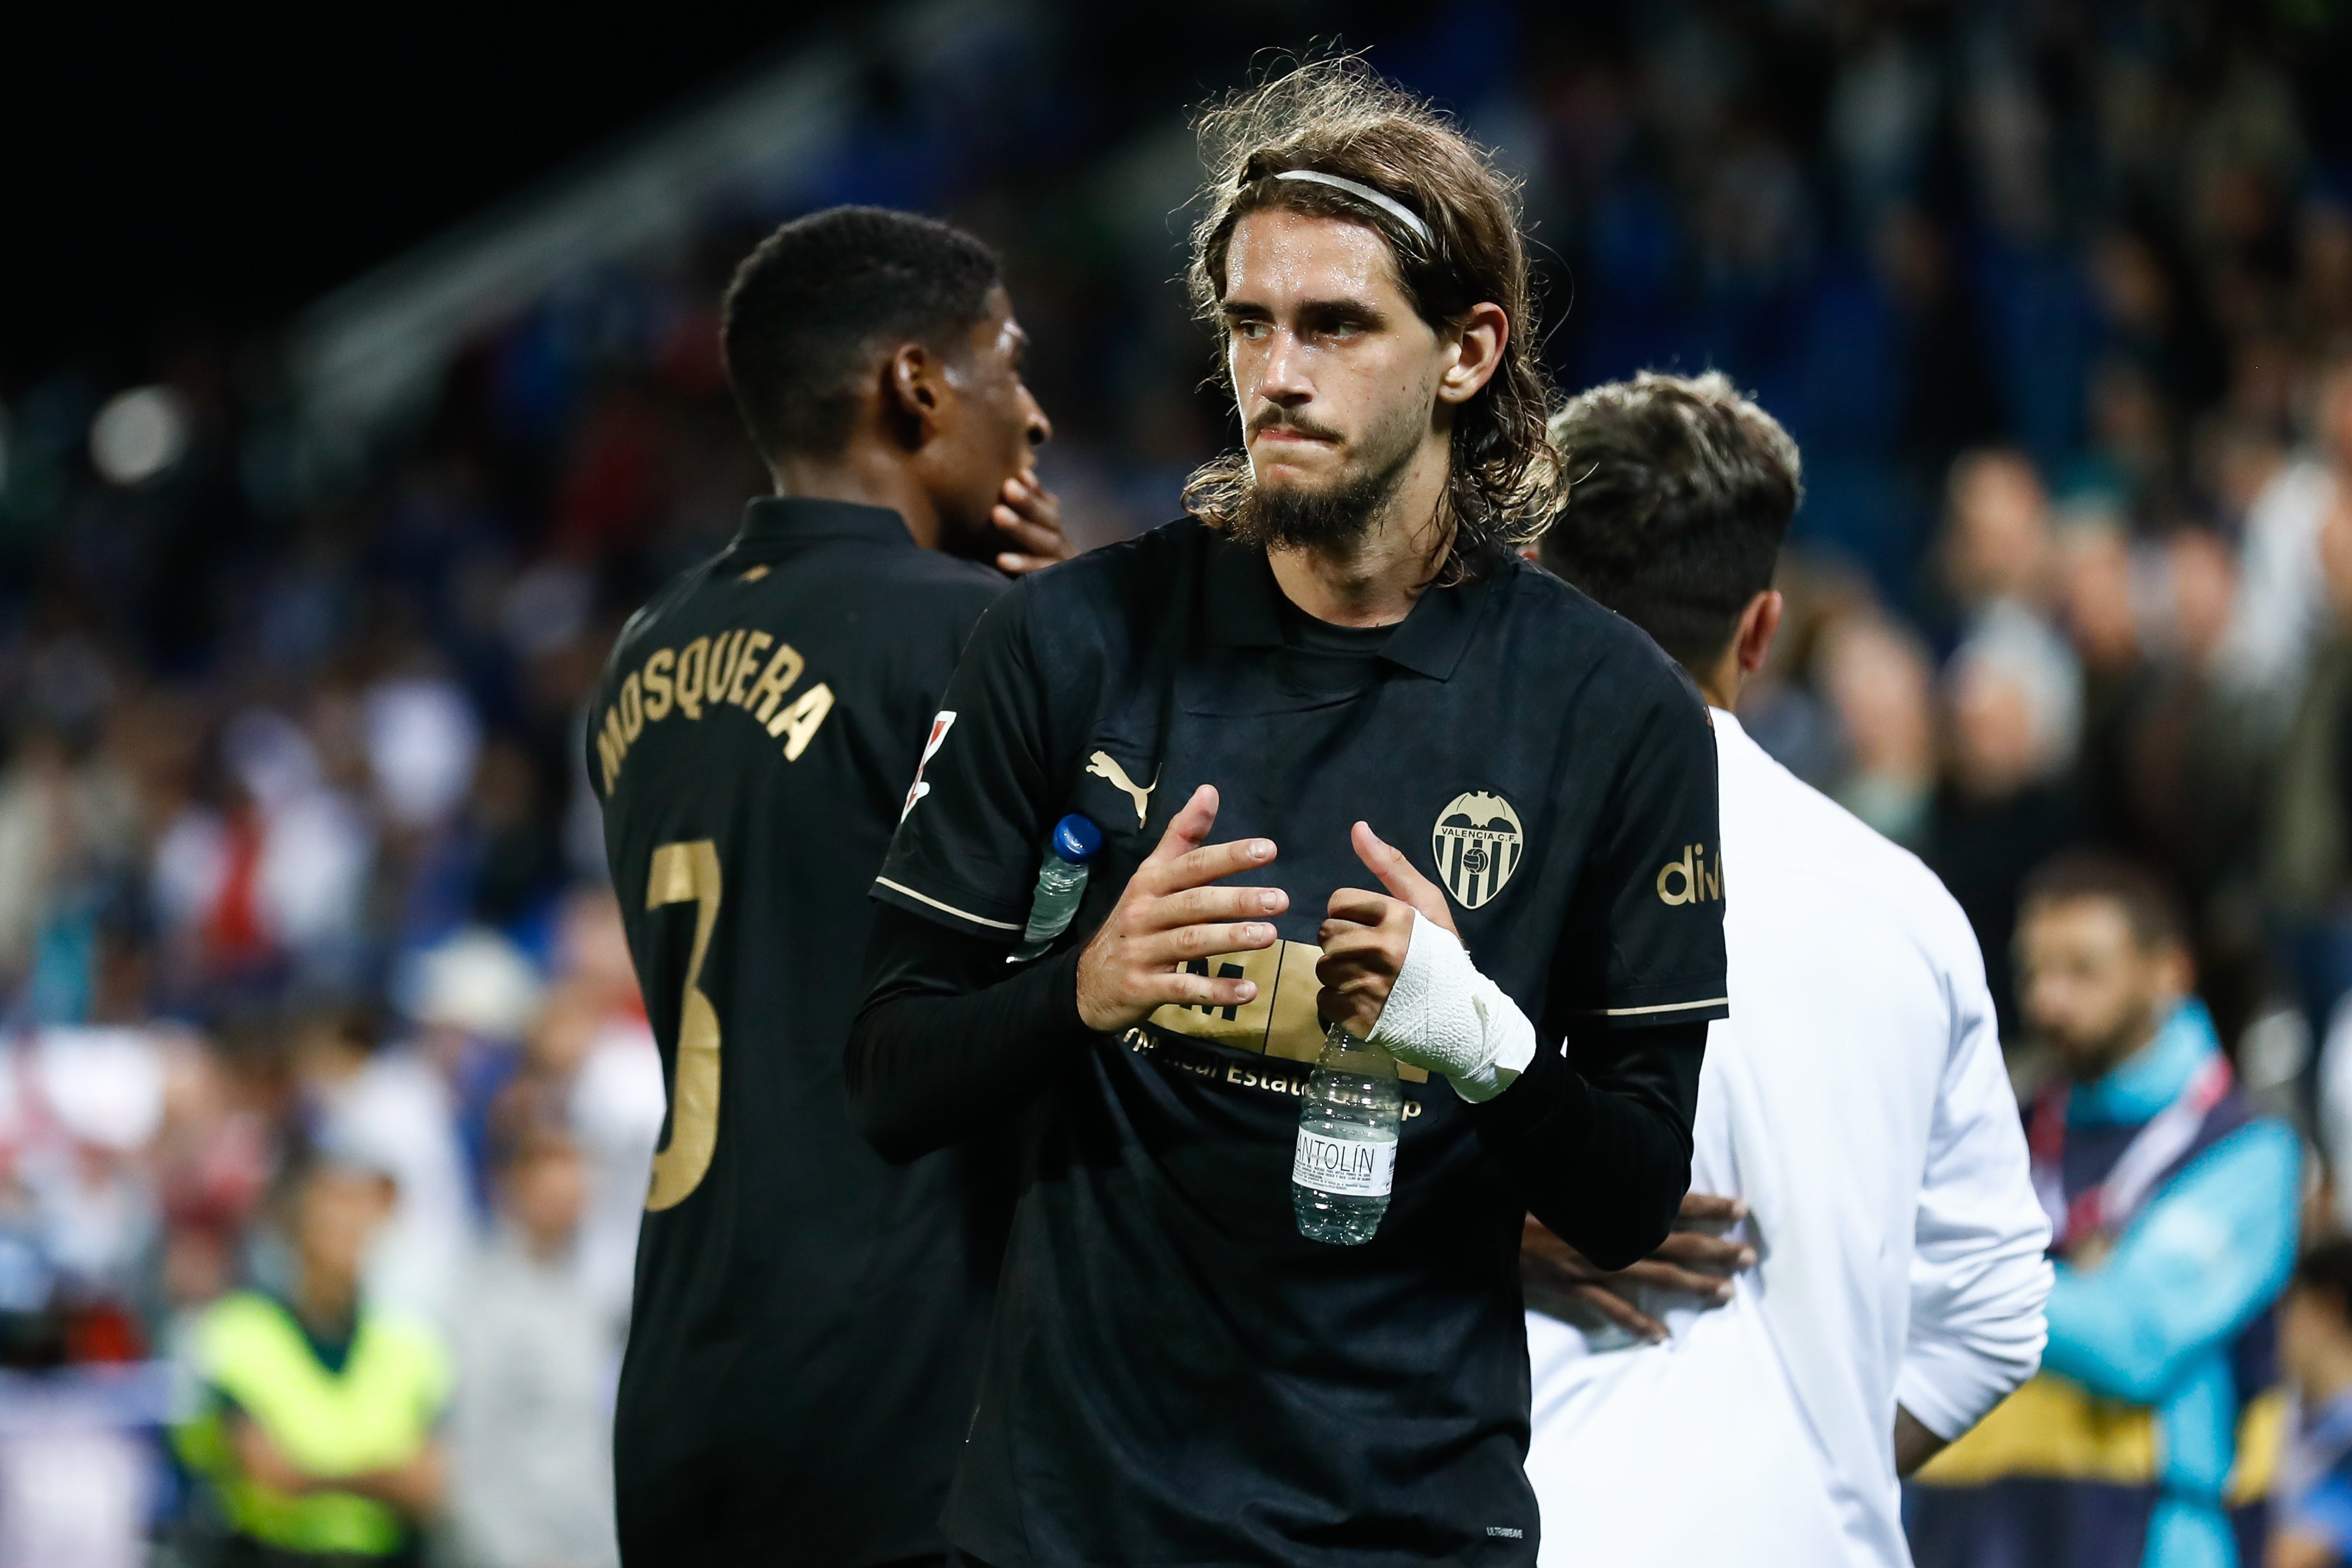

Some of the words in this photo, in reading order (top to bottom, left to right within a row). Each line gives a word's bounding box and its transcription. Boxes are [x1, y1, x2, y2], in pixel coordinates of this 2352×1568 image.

[596, 629, 836, 796] MOSQUERA
[1441, 827, 1494, 841] VALENCIA
[1497, 833, 1517, 843] C.F.
[1656, 842, 1725, 906] div
[645, 838, 723, 1213] 3
